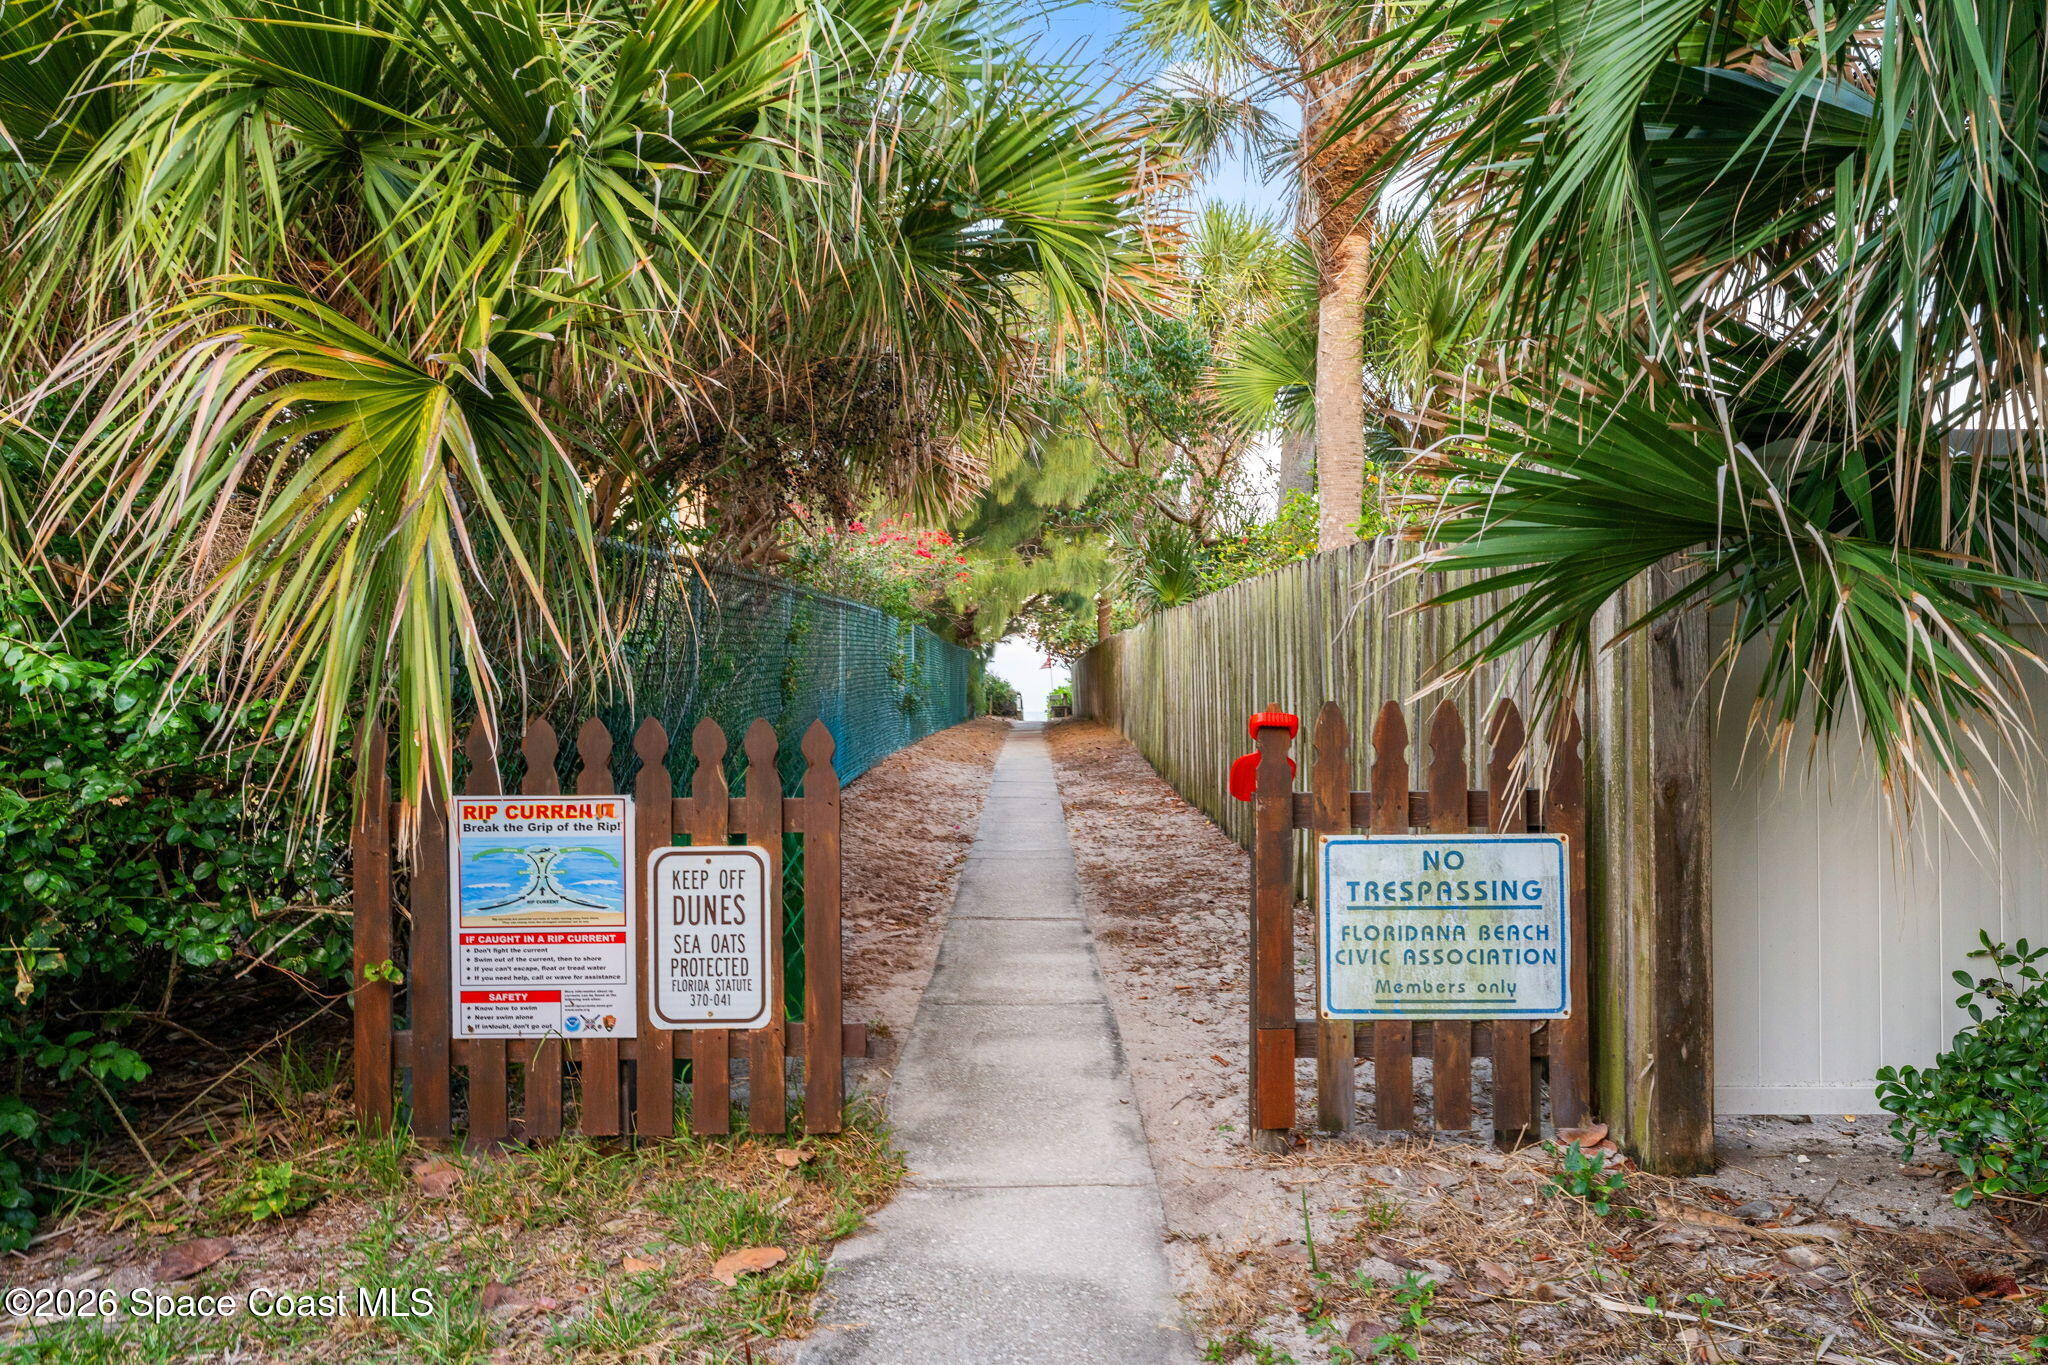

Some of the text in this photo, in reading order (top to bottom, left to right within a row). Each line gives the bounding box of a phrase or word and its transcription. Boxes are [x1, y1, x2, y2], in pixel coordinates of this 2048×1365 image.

[463, 805, 498, 820] RIP
[463, 822, 620, 834] Break the Grip of the Rip!
[1423, 850, 1465, 871] NO
[672, 869, 746, 890] KEEP OFF
[1346, 880, 1543, 901] TRESPASSING
[673, 894, 746, 925] DUNES
[1341, 924, 1549, 942] FLORIDANA BEACH
[674, 934, 746, 954] SEA OATS
[1335, 948, 1557, 966] CIVIC ASSOCIATION
[671, 958, 749, 977] PROTECTED
[672, 979, 752, 992] FLORIDA STATUTE
[1375, 979, 1517, 997] Members only
[489, 993, 528, 1001] SAFETY
[690, 994, 731, 1007] 370-041
